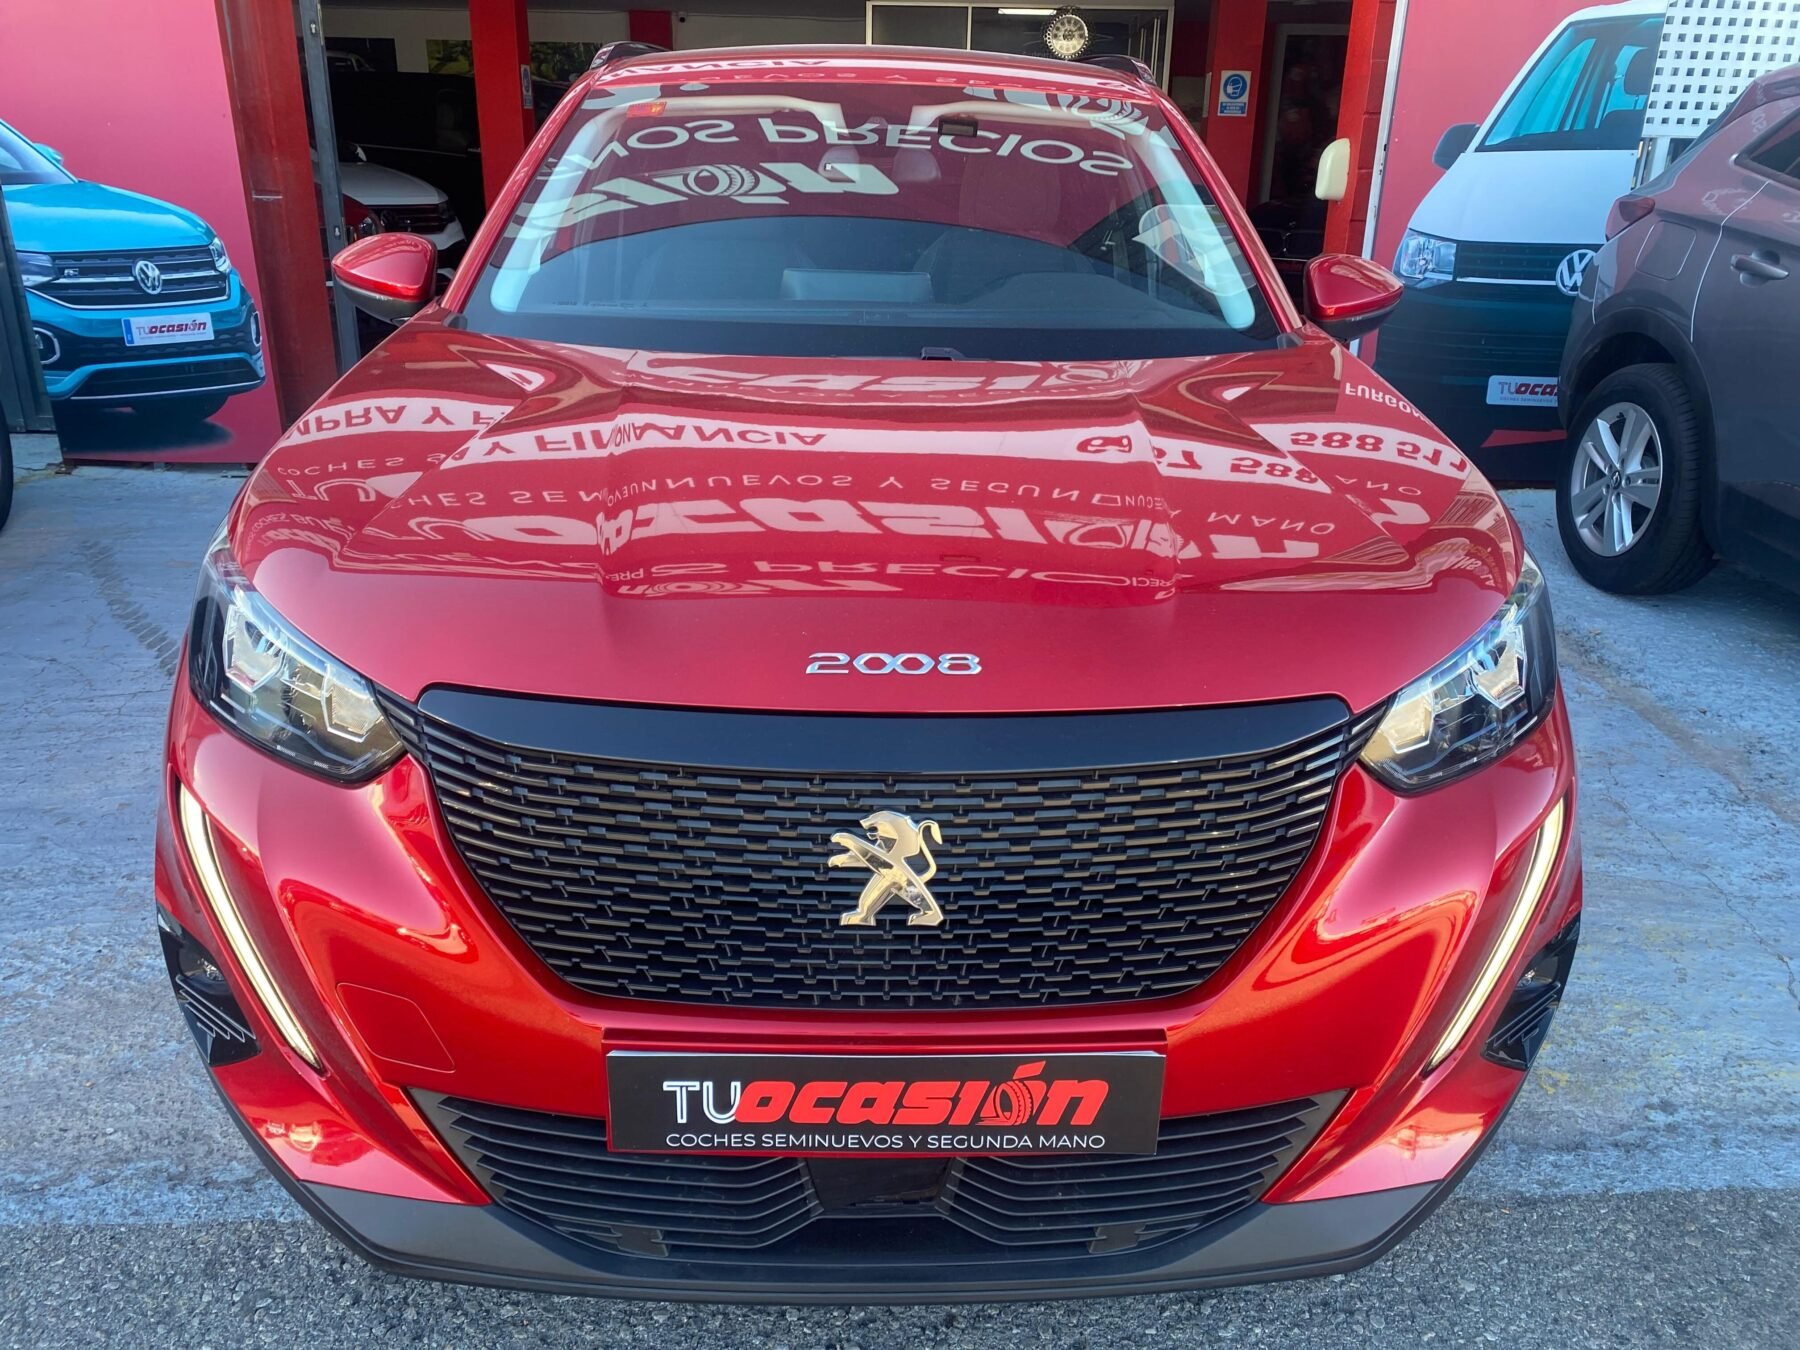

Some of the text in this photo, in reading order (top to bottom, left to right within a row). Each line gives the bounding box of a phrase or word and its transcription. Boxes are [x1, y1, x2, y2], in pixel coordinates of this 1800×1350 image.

[1498, 381, 1558, 397] TUoca
[805, 651, 983, 675] 2008
[665, 1132, 1106, 1150] COCHES SEMINUEVOS Y SEGUNDA MANO
